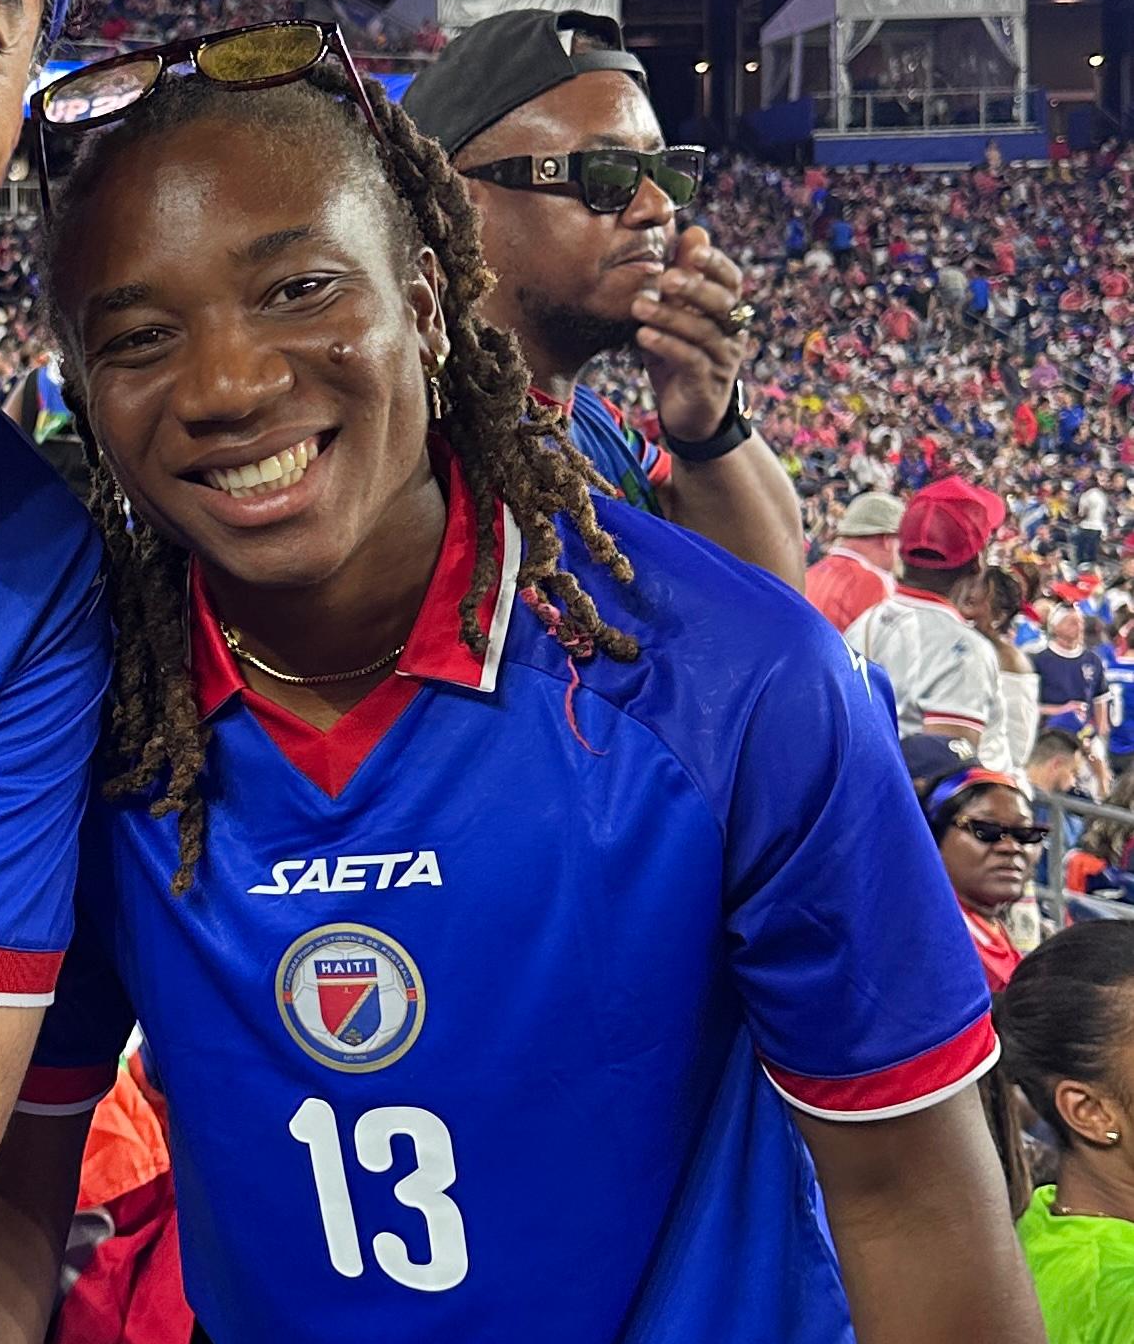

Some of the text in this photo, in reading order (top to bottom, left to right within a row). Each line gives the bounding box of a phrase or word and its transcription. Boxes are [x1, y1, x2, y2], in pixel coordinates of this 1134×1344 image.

[246, 850, 443, 895] SAETA
[320, 960, 371, 974] HAITI
[288, 1097, 469, 1293] 13
